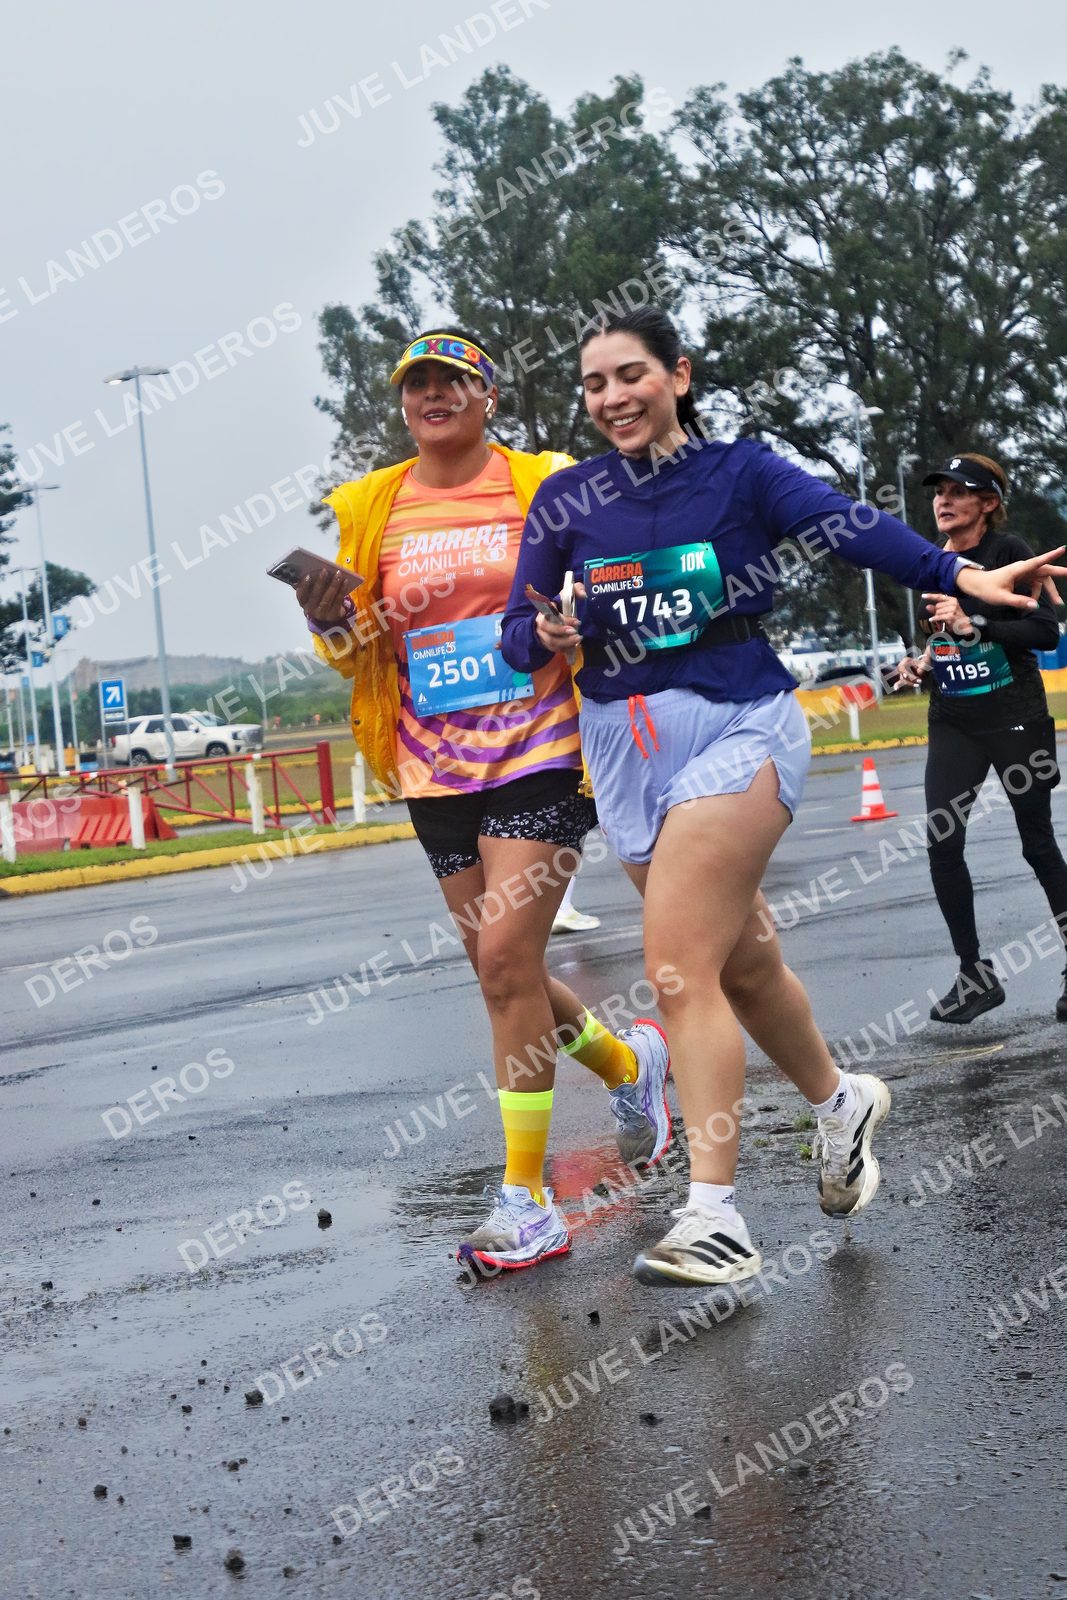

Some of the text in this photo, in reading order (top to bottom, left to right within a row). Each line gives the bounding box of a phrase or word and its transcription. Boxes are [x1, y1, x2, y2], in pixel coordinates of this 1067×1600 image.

[410, 338, 480, 365] EXICO
[400, 524, 508, 559] CARRERA
[398, 549, 483, 577] OMNILIFE
[591, 562, 643, 583] CARRERA
[680, 551, 706, 573] 10K
[592, 580, 633, 594] OMNILIFE
[612, 588, 693, 625] 1743
[413, 645, 446, 660] OMNILIFE
[427, 652, 496, 688] 2501
[946, 661, 990, 681] 1195
